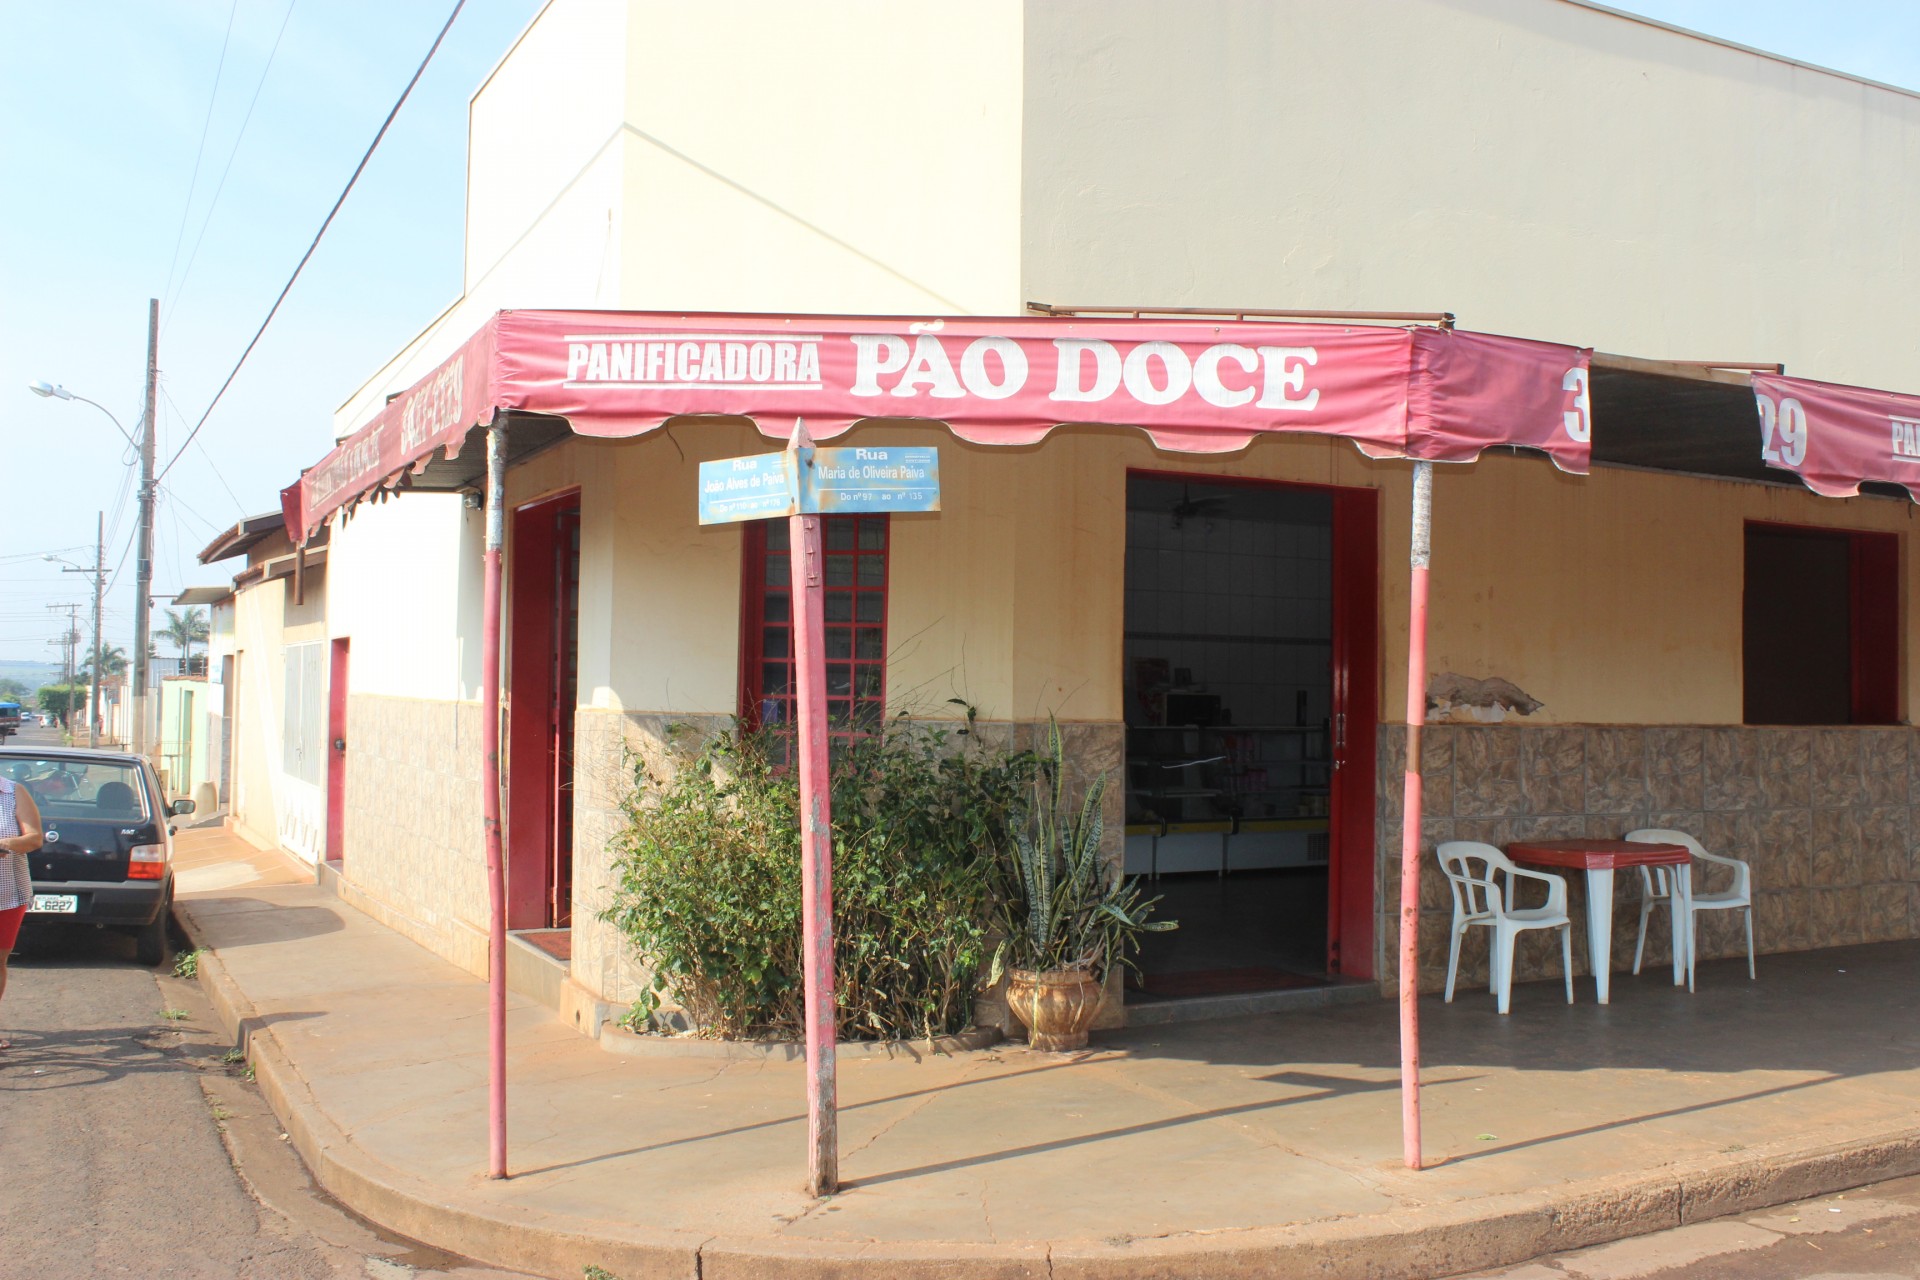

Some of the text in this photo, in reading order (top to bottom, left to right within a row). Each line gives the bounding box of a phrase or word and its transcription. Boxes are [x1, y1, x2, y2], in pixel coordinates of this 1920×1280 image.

[567, 319, 1320, 411] PANIFICADORA PÃO DOCE
[1756, 394, 1807, 467] 29
[855, 448, 888, 461] Rua
[732, 459, 758, 472] Rua
[818, 465, 925, 480] Maria de Oliveira Paiva
[704, 472, 784, 494] João Alves de Paiva
[840, 492, 852, 501] Do
[881, 493, 892, 501] ao
[909, 492, 923, 500] 135
